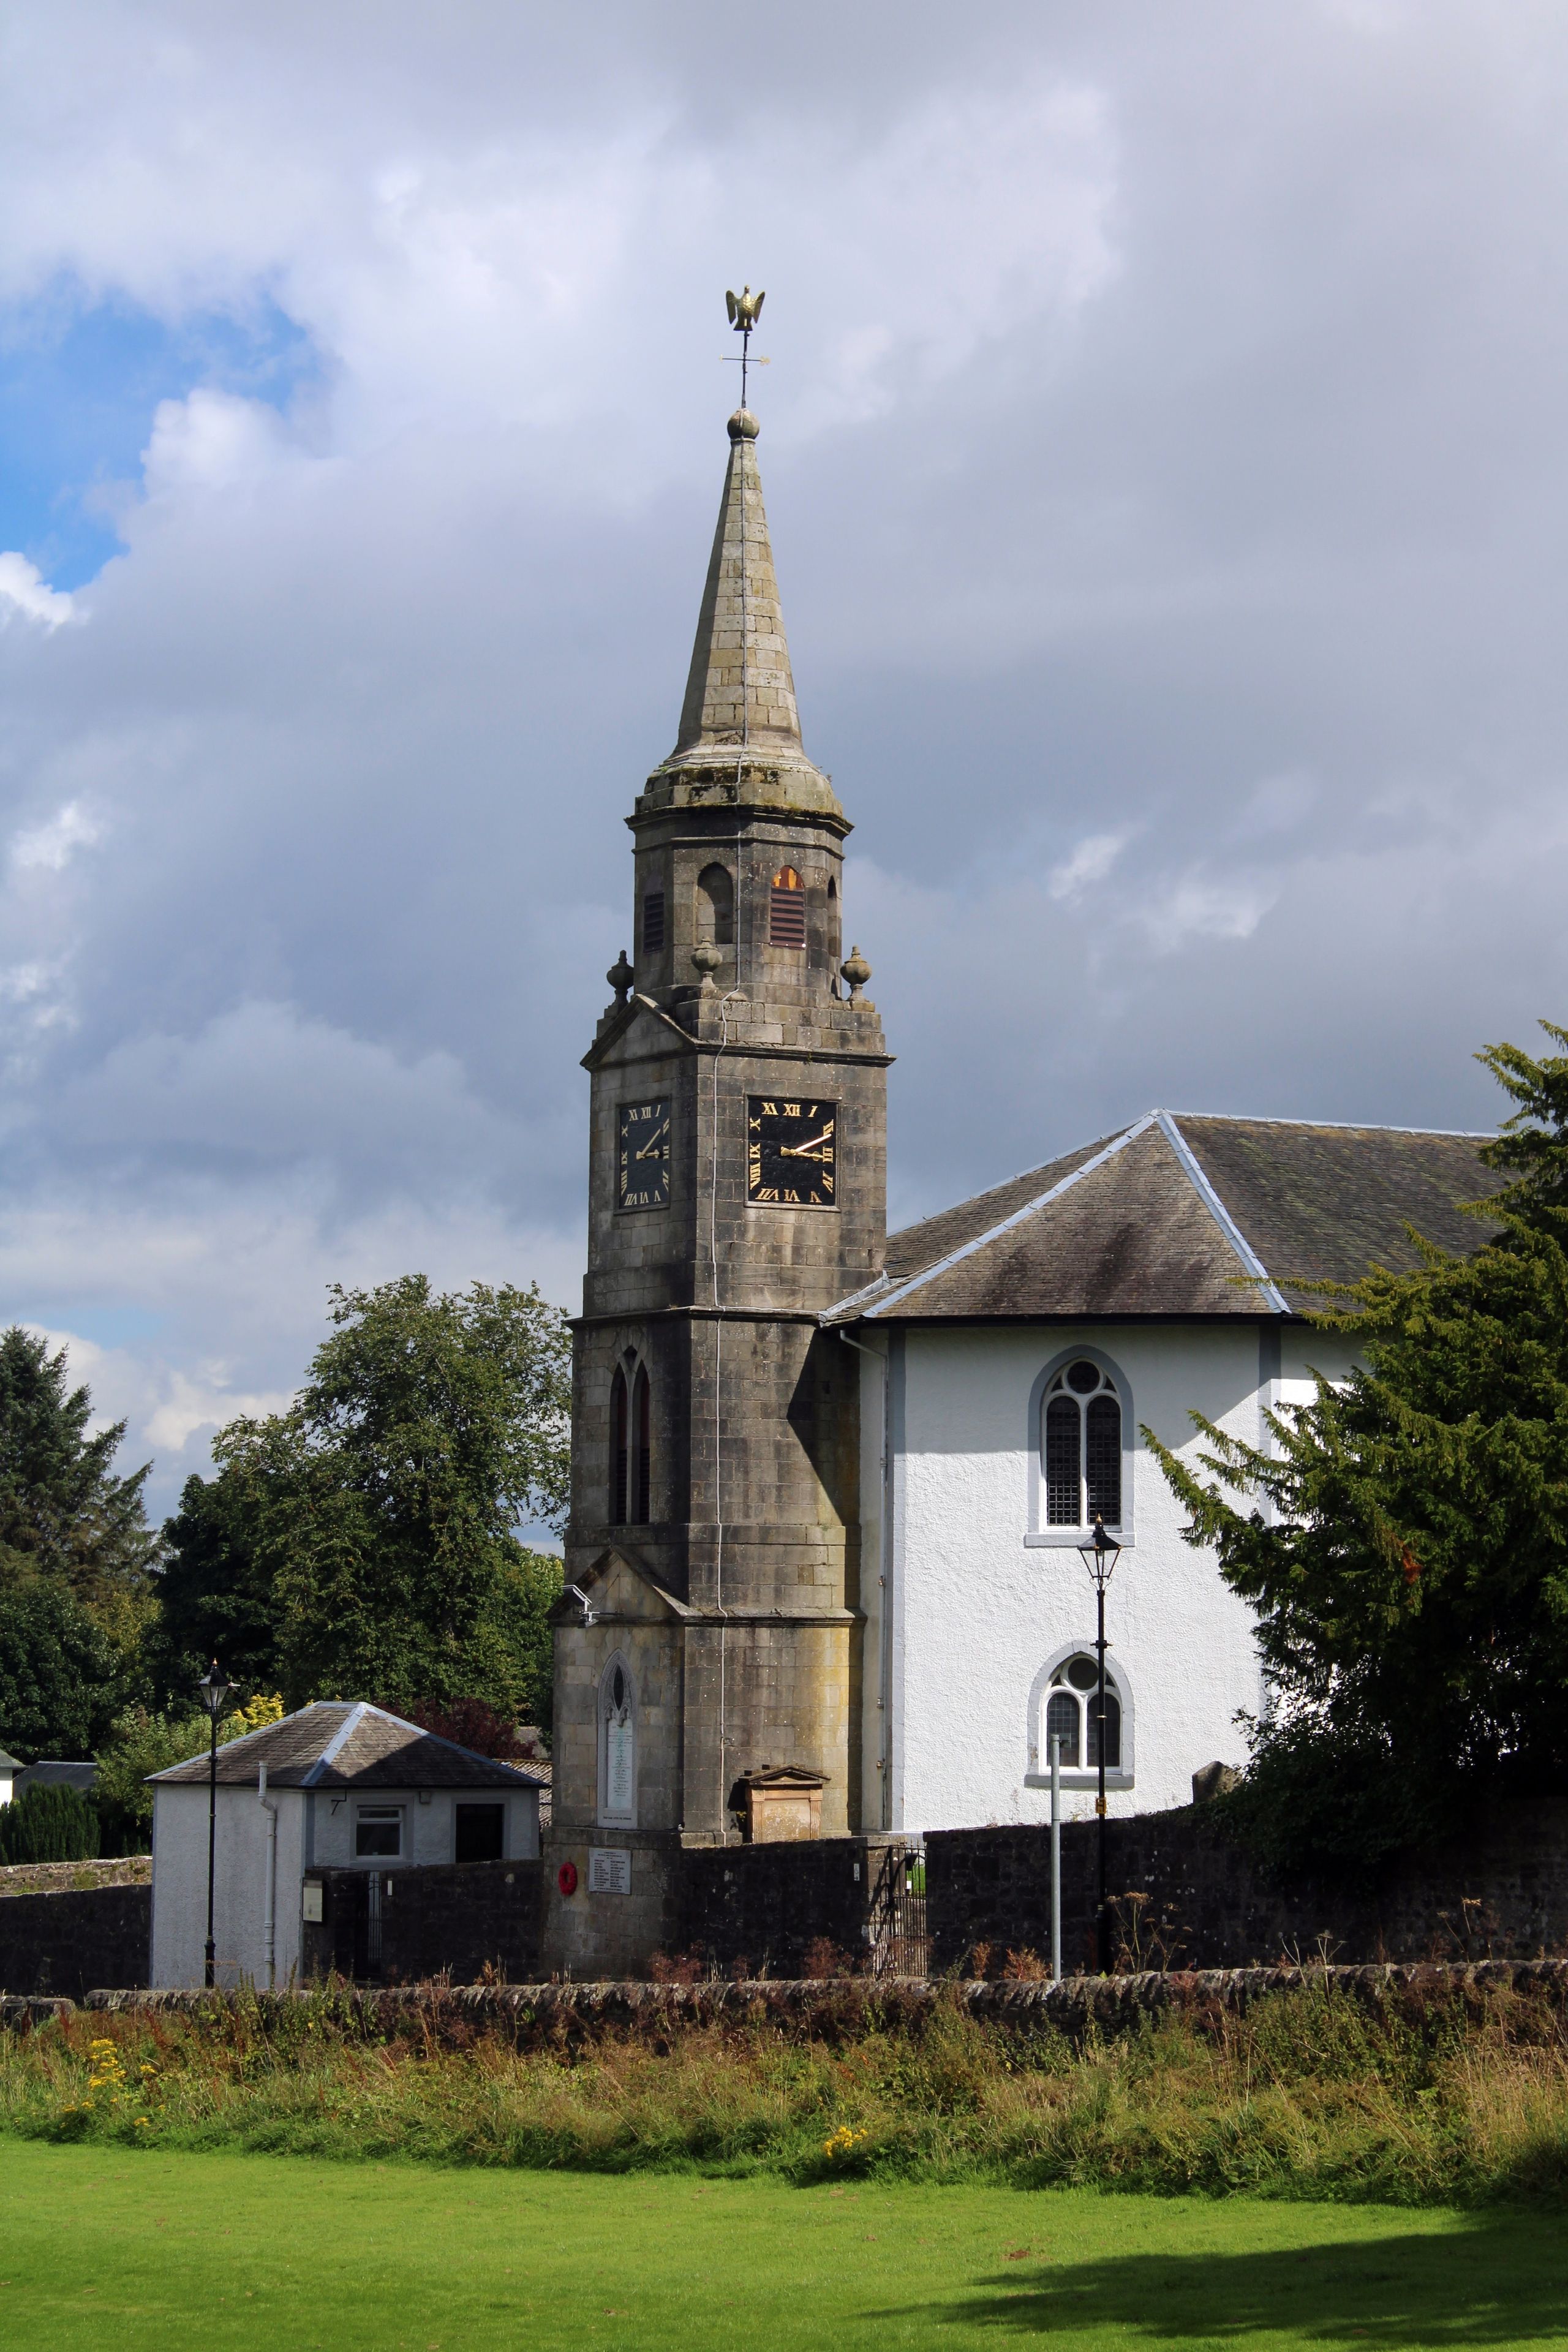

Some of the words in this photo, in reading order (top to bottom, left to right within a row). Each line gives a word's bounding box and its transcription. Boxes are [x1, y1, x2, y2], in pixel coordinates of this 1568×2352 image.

[641, 1106, 652, 1119] XII
[655, 1105, 661, 1117] I
[761, 1102, 778, 1115] XI
[783, 1104, 802, 1116] XII
[808, 1106, 818, 1117] I
[628, 1109, 638, 1121] XI
[750, 1117, 761, 1131] X
[622, 1125, 628, 1137] X
[750, 1143, 761, 1159] IX
[823, 1147, 833, 1163] III
[622, 1150, 627, 1165] IX
[654, 1190, 661, 1202] V
[755, 1188, 780, 1200] VII
[784, 1189, 801, 1202] VI
[810, 1191, 822, 1202] V
